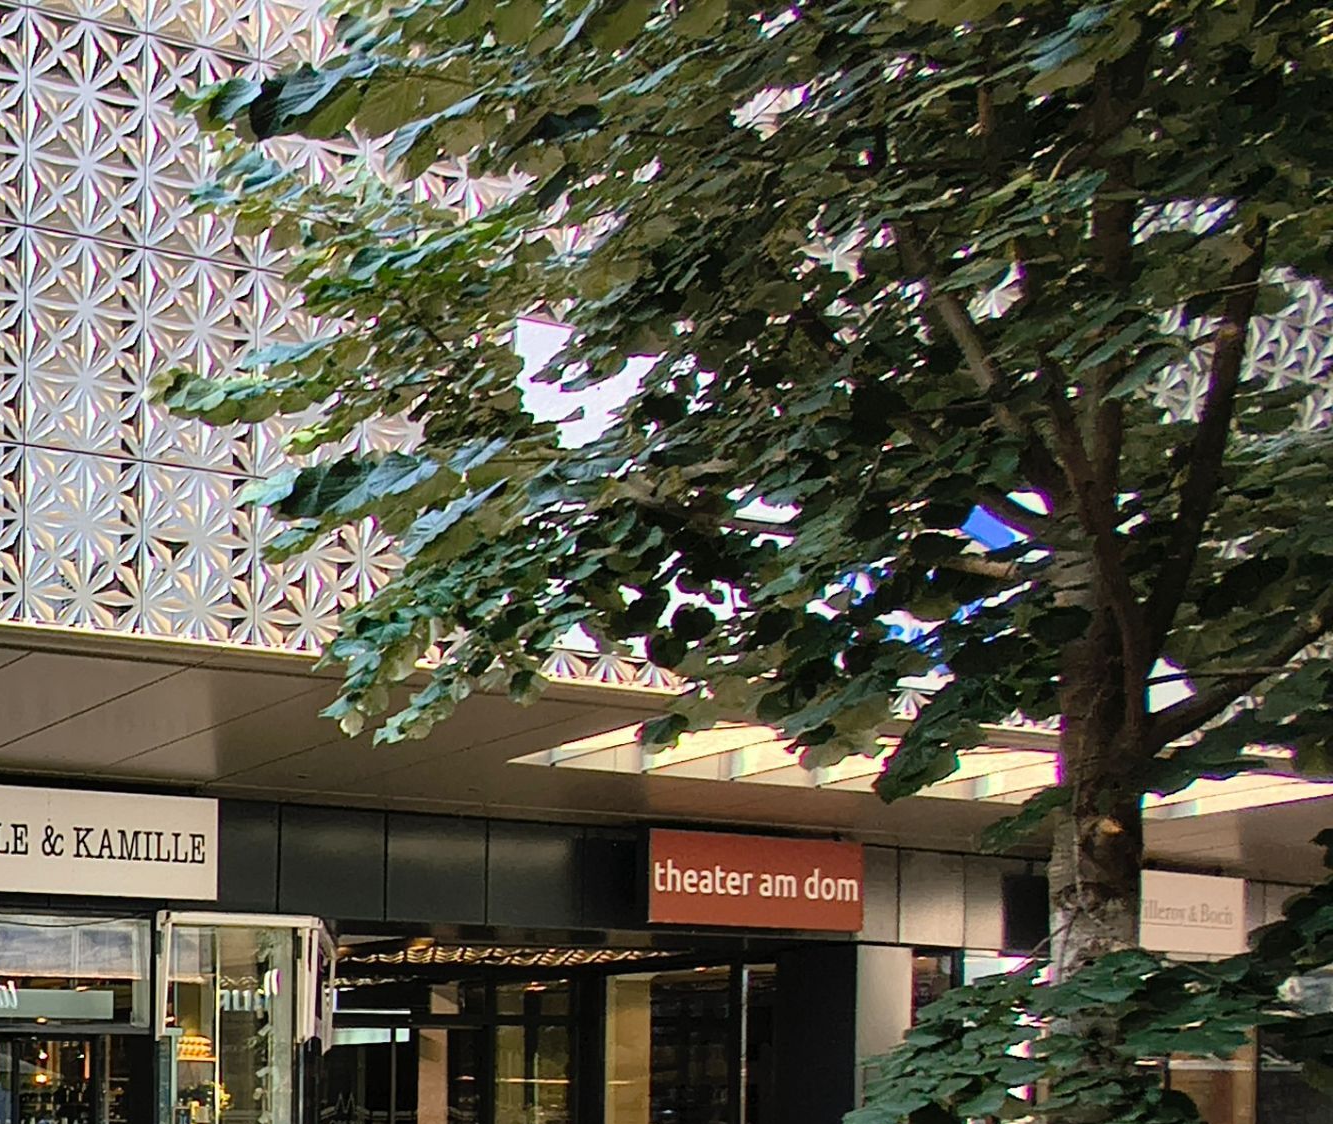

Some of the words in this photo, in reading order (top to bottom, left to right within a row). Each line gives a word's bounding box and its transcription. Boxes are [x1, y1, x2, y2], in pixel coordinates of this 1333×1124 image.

[41, 824, 64, 856] &
[73, 826, 206, 864] KAMILLE
[654, 859, 753, 896] theater
[758, 873, 798, 898] am
[804, 868, 859, 902] dom
